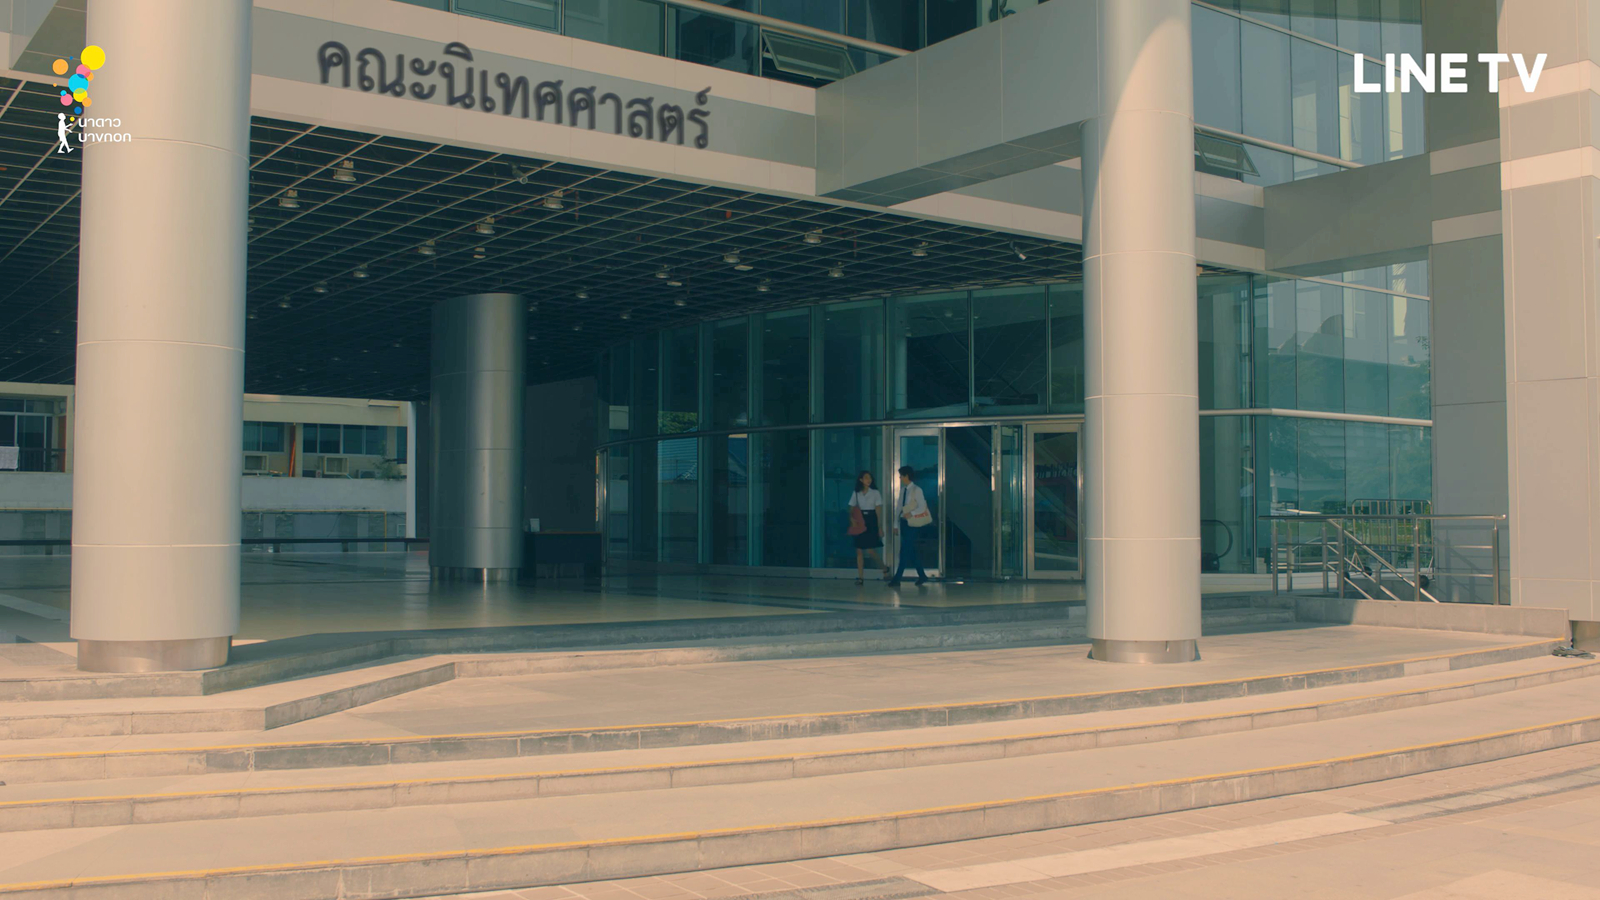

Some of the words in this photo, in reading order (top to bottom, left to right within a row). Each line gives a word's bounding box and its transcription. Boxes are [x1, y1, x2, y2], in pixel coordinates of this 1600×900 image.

[317, 41, 711, 149] คณะนิเทศศาสตร์
